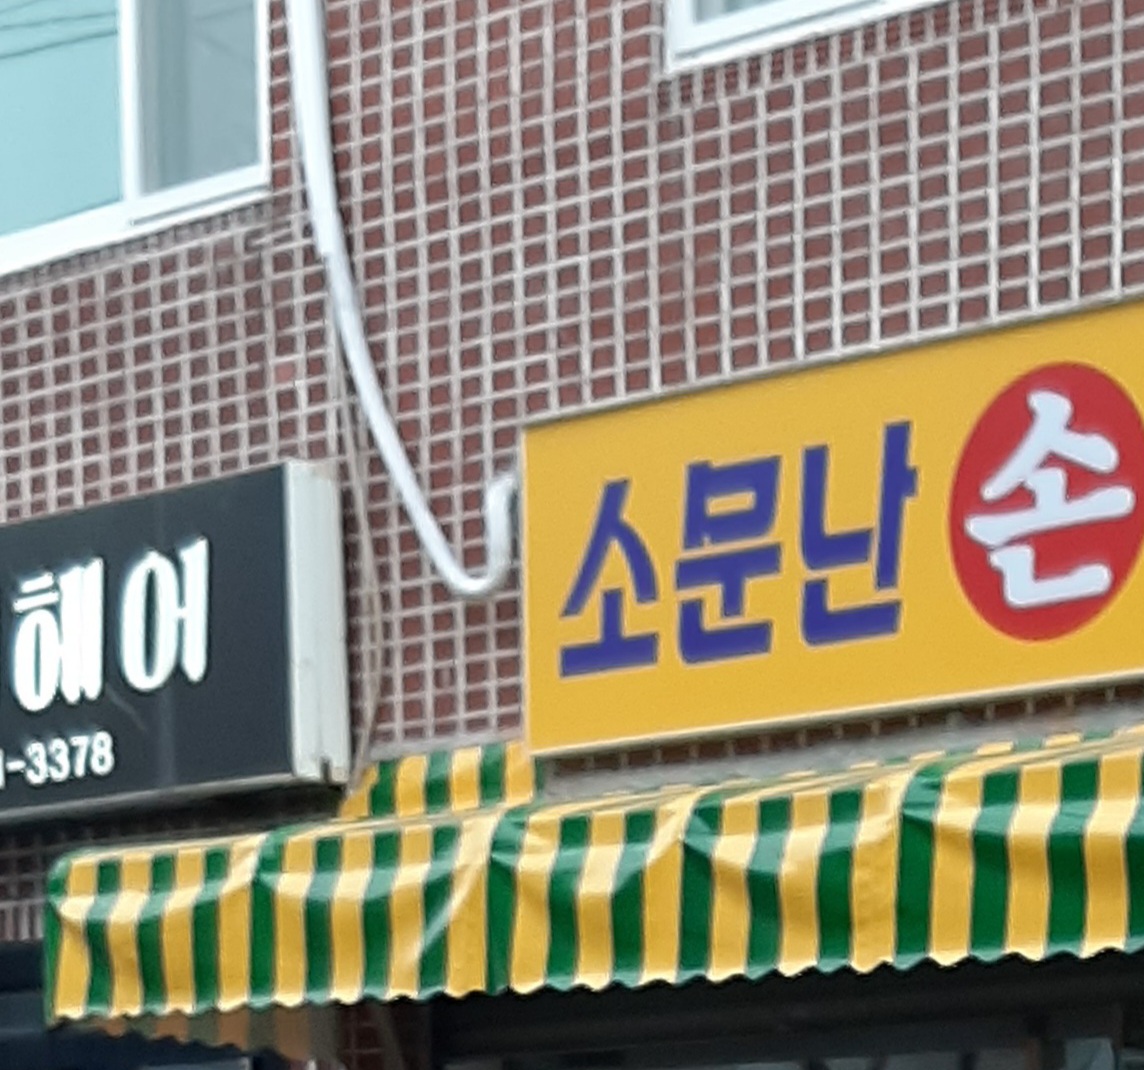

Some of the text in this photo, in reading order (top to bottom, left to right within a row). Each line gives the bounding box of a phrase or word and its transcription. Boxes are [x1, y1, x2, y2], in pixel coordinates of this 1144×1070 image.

[13, 536, 209, 712] 헤어
[556, 417, 919, 679] 소문난
[964, 389, 1136, 609] 손
